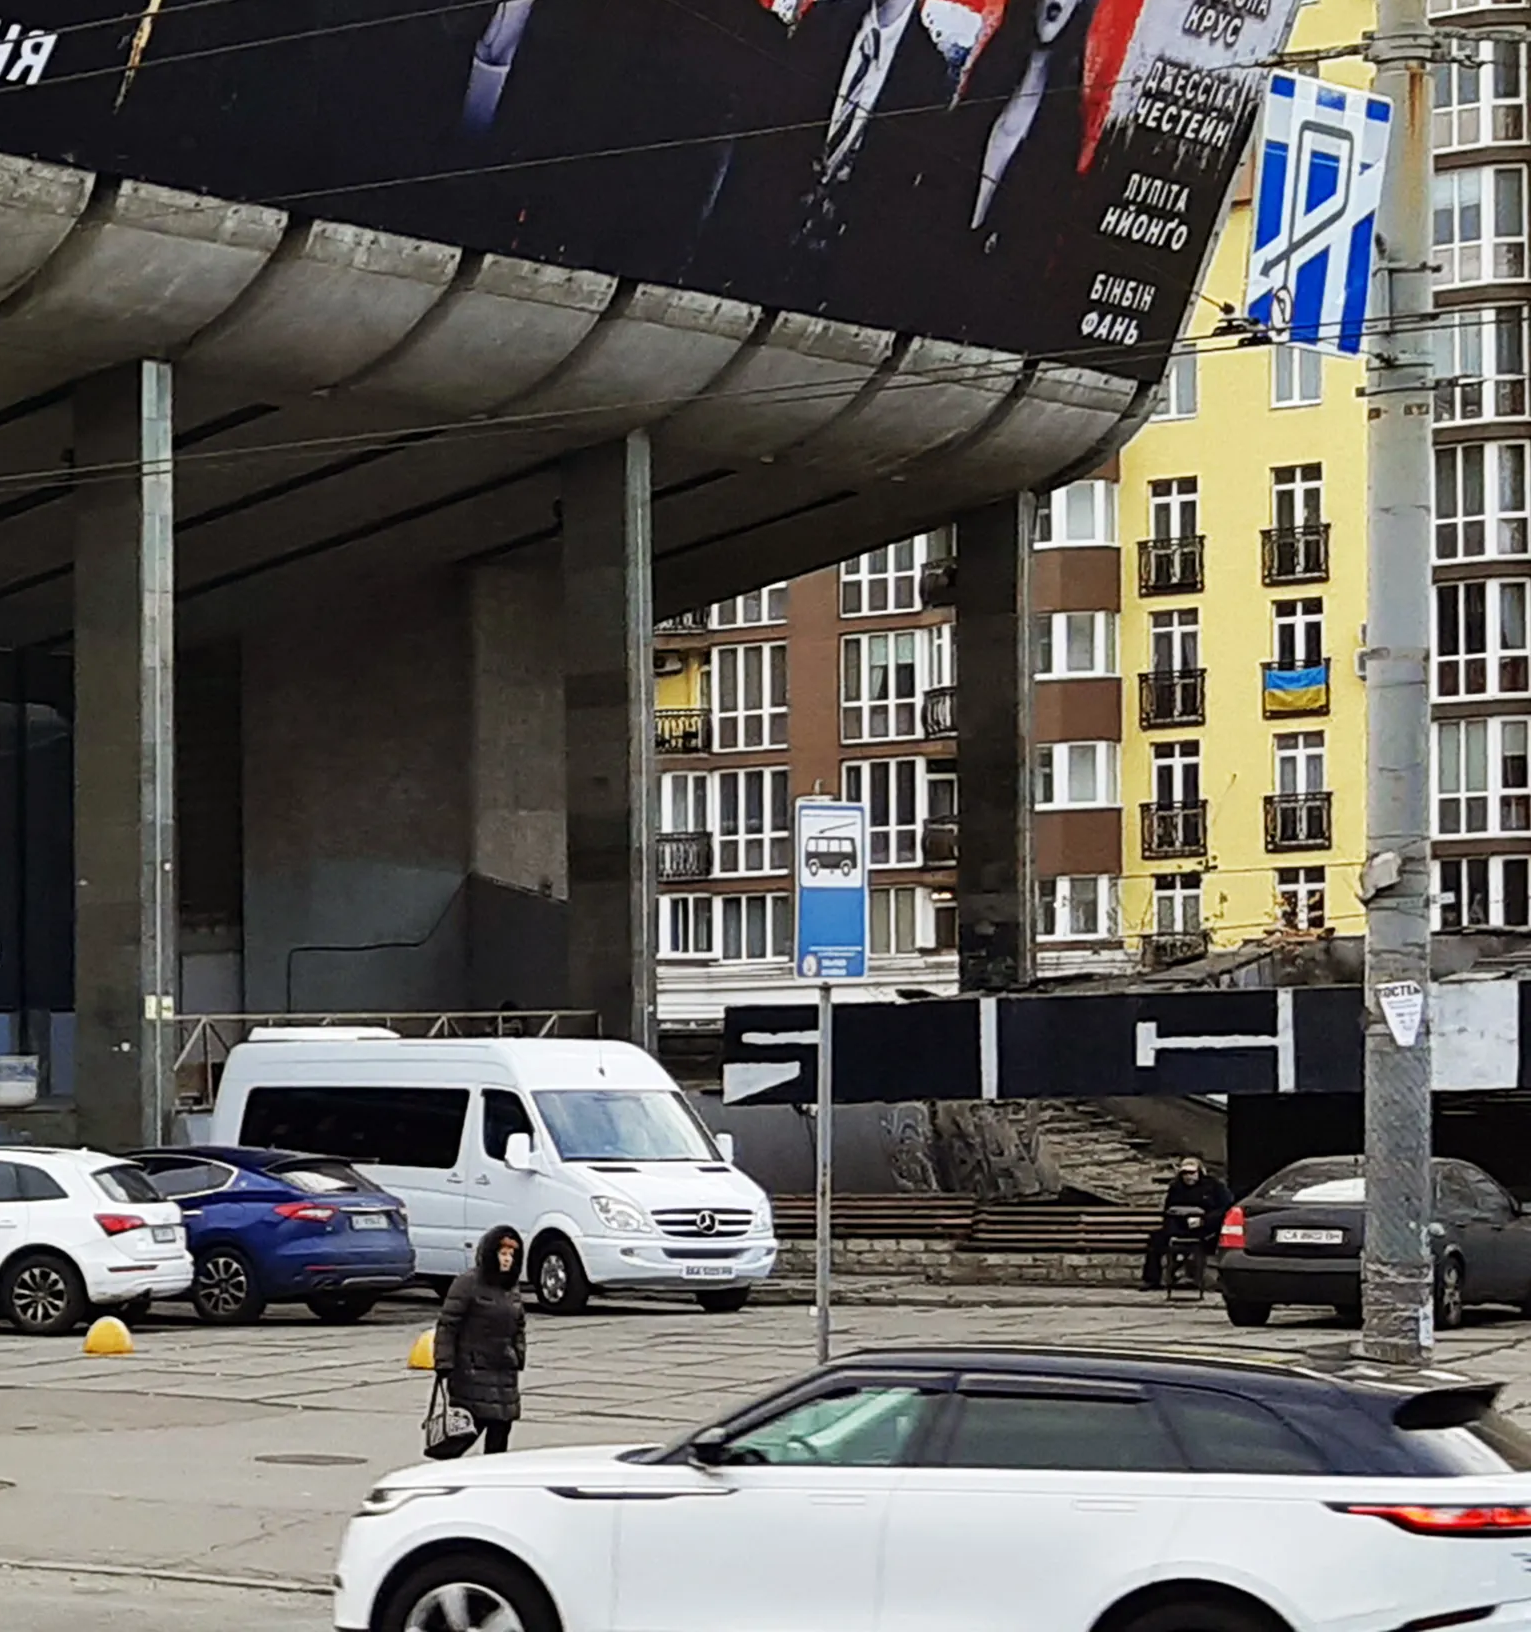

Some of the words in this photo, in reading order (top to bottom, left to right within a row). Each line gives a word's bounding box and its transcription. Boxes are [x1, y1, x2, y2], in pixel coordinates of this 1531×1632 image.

[1185, 13, 1242, 45] КРУС
[1137, 96, 1231, 148] ЧЕСТЕЙН
[1123, 173, 1190, 213] ЛУПІТА
